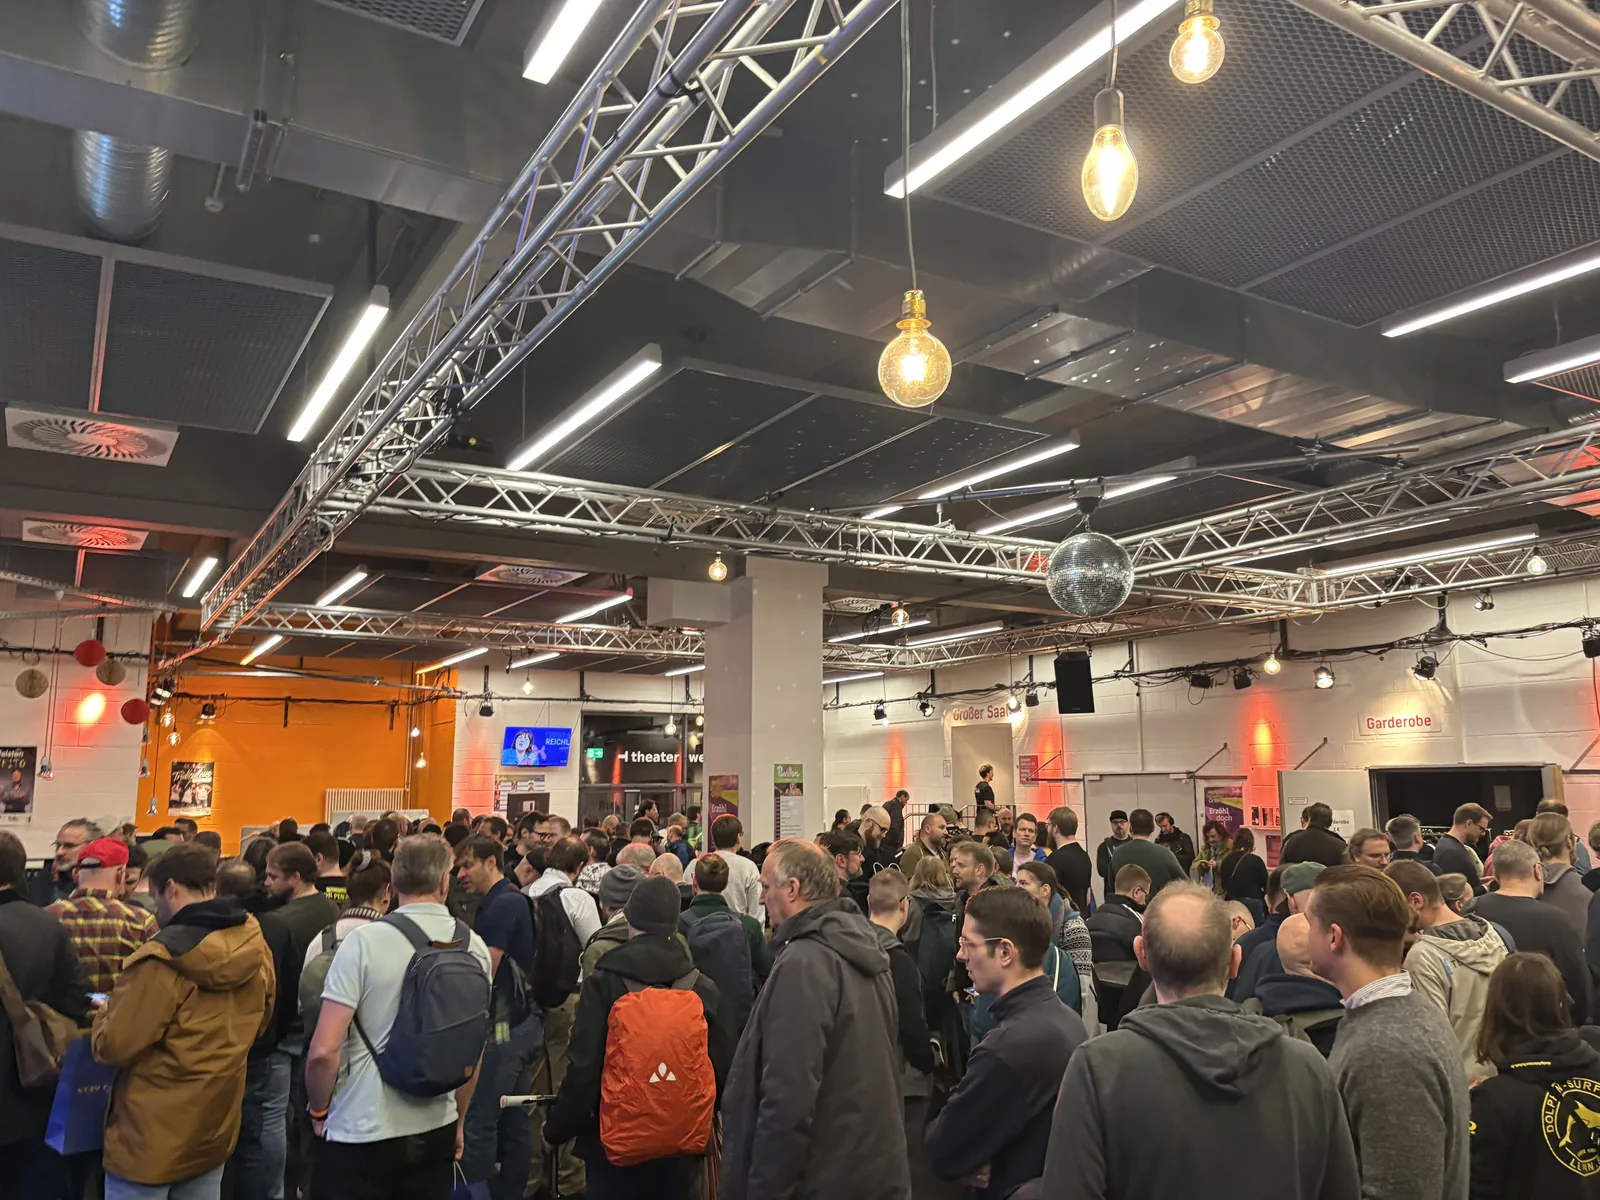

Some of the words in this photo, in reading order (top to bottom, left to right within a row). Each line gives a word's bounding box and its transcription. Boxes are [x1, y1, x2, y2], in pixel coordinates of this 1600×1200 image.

[953, 706, 984, 721] Großer
[1366, 715, 1432, 729] Garderobe
[545, 738, 570, 746] REICHL
[631, 751, 680, 763] theater
[1216, 814, 1233, 822] doch
